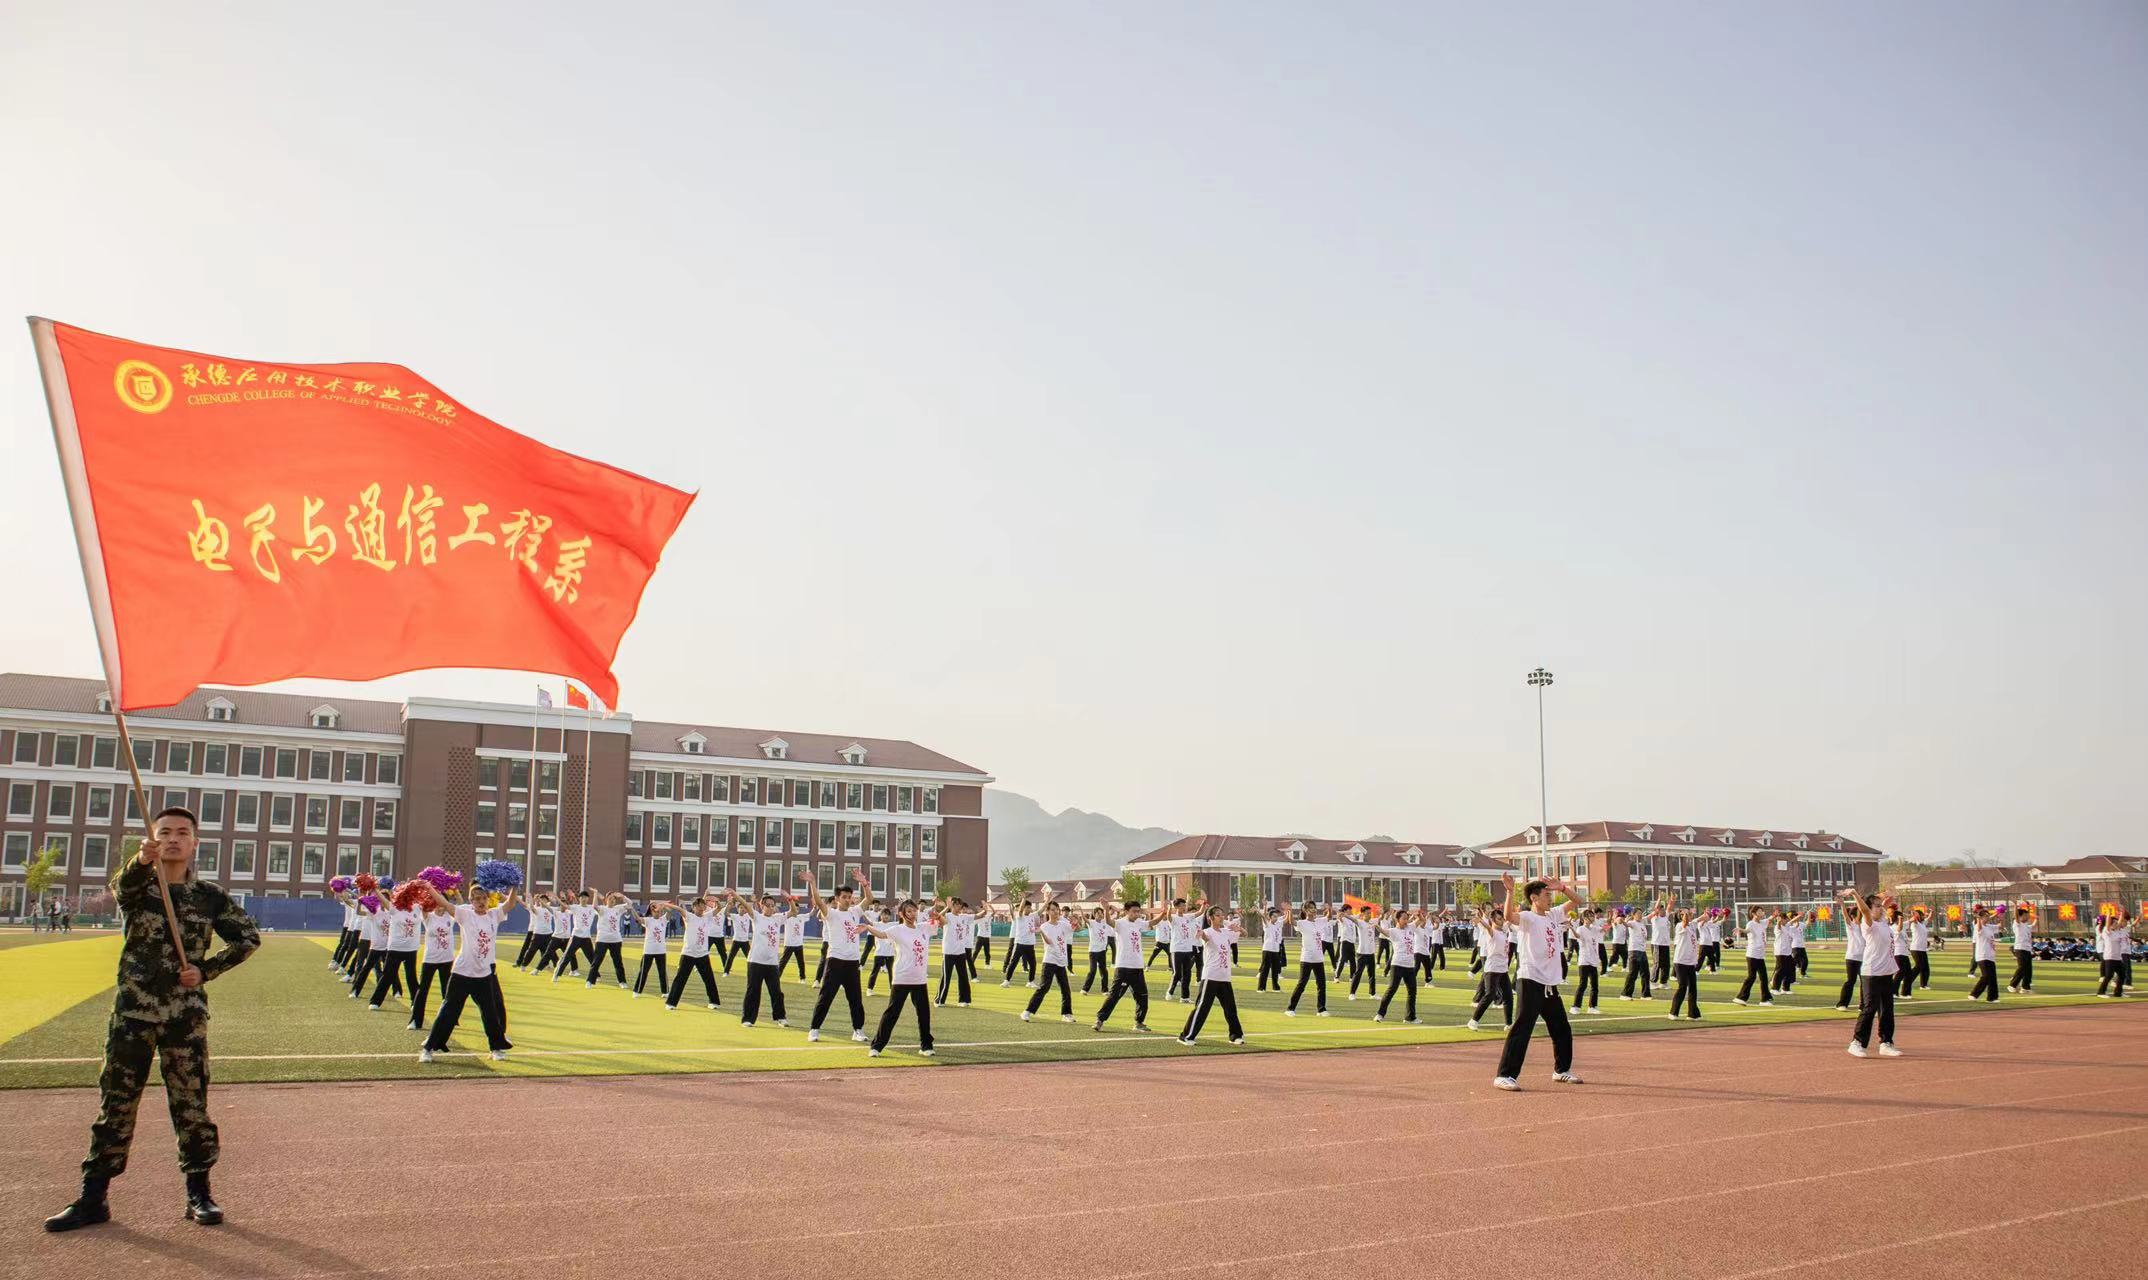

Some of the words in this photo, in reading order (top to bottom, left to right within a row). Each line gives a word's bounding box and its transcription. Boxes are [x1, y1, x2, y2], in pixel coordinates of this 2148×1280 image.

[181, 363, 457, 417] 承德应用技术职业学院
[187, 393, 240, 405] CHENGDE
[243, 389, 295, 401] COLLEGE
[299, 390, 315, 399] OF
[320, 393, 370, 406] APPLIED
[374, 400, 452, 426] TECHNOLOGY
[187, 482, 592, 605] 电子与通信工程系
